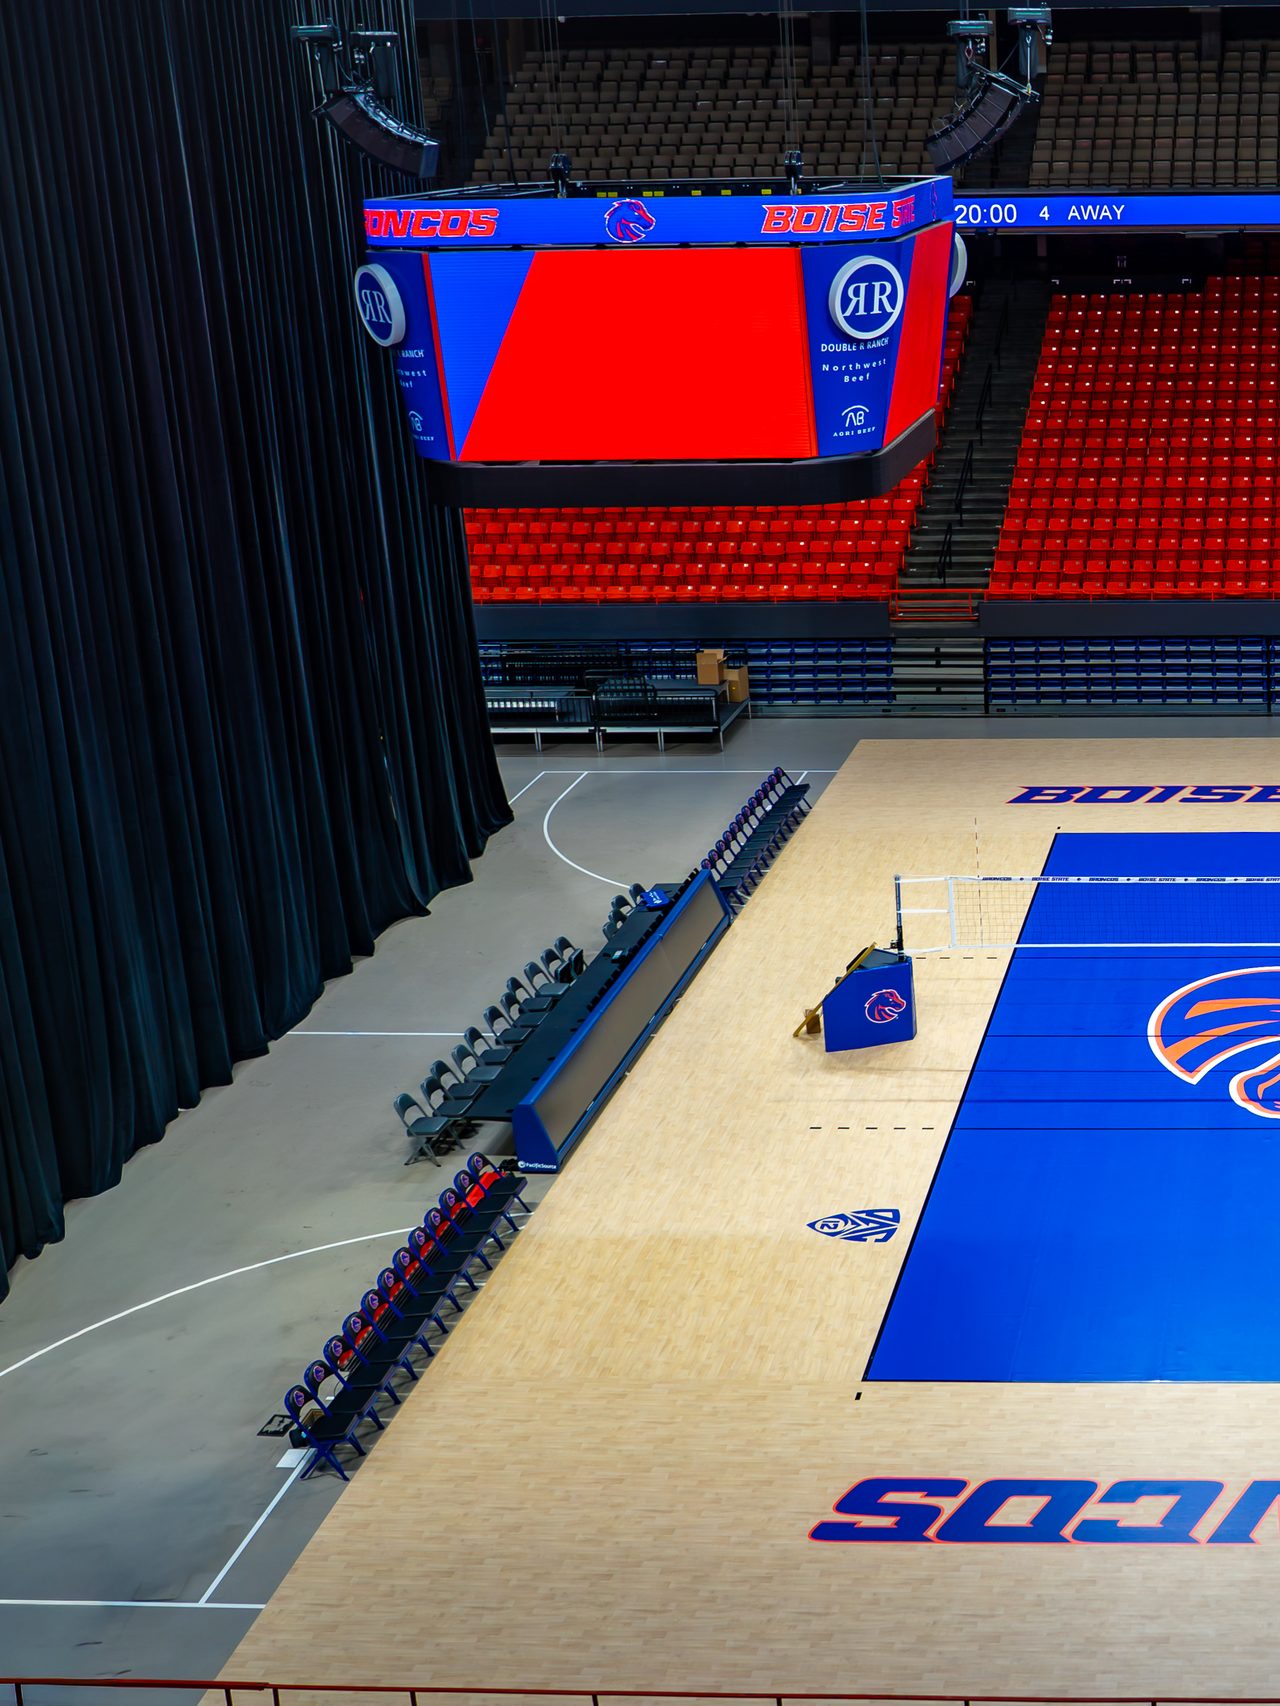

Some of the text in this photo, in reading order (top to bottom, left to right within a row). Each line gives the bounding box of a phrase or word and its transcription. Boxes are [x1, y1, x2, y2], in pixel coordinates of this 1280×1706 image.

[761, 201, 888, 234] BOISE
[954, 203, 1125, 224] 20:00 4 AWAY
[820, 342, 857, 352] DOUBLE
[866, 337, 889, 350] RANCH
[822, 358, 886, 372] Northwest
[844, 373, 871, 383] Beef
